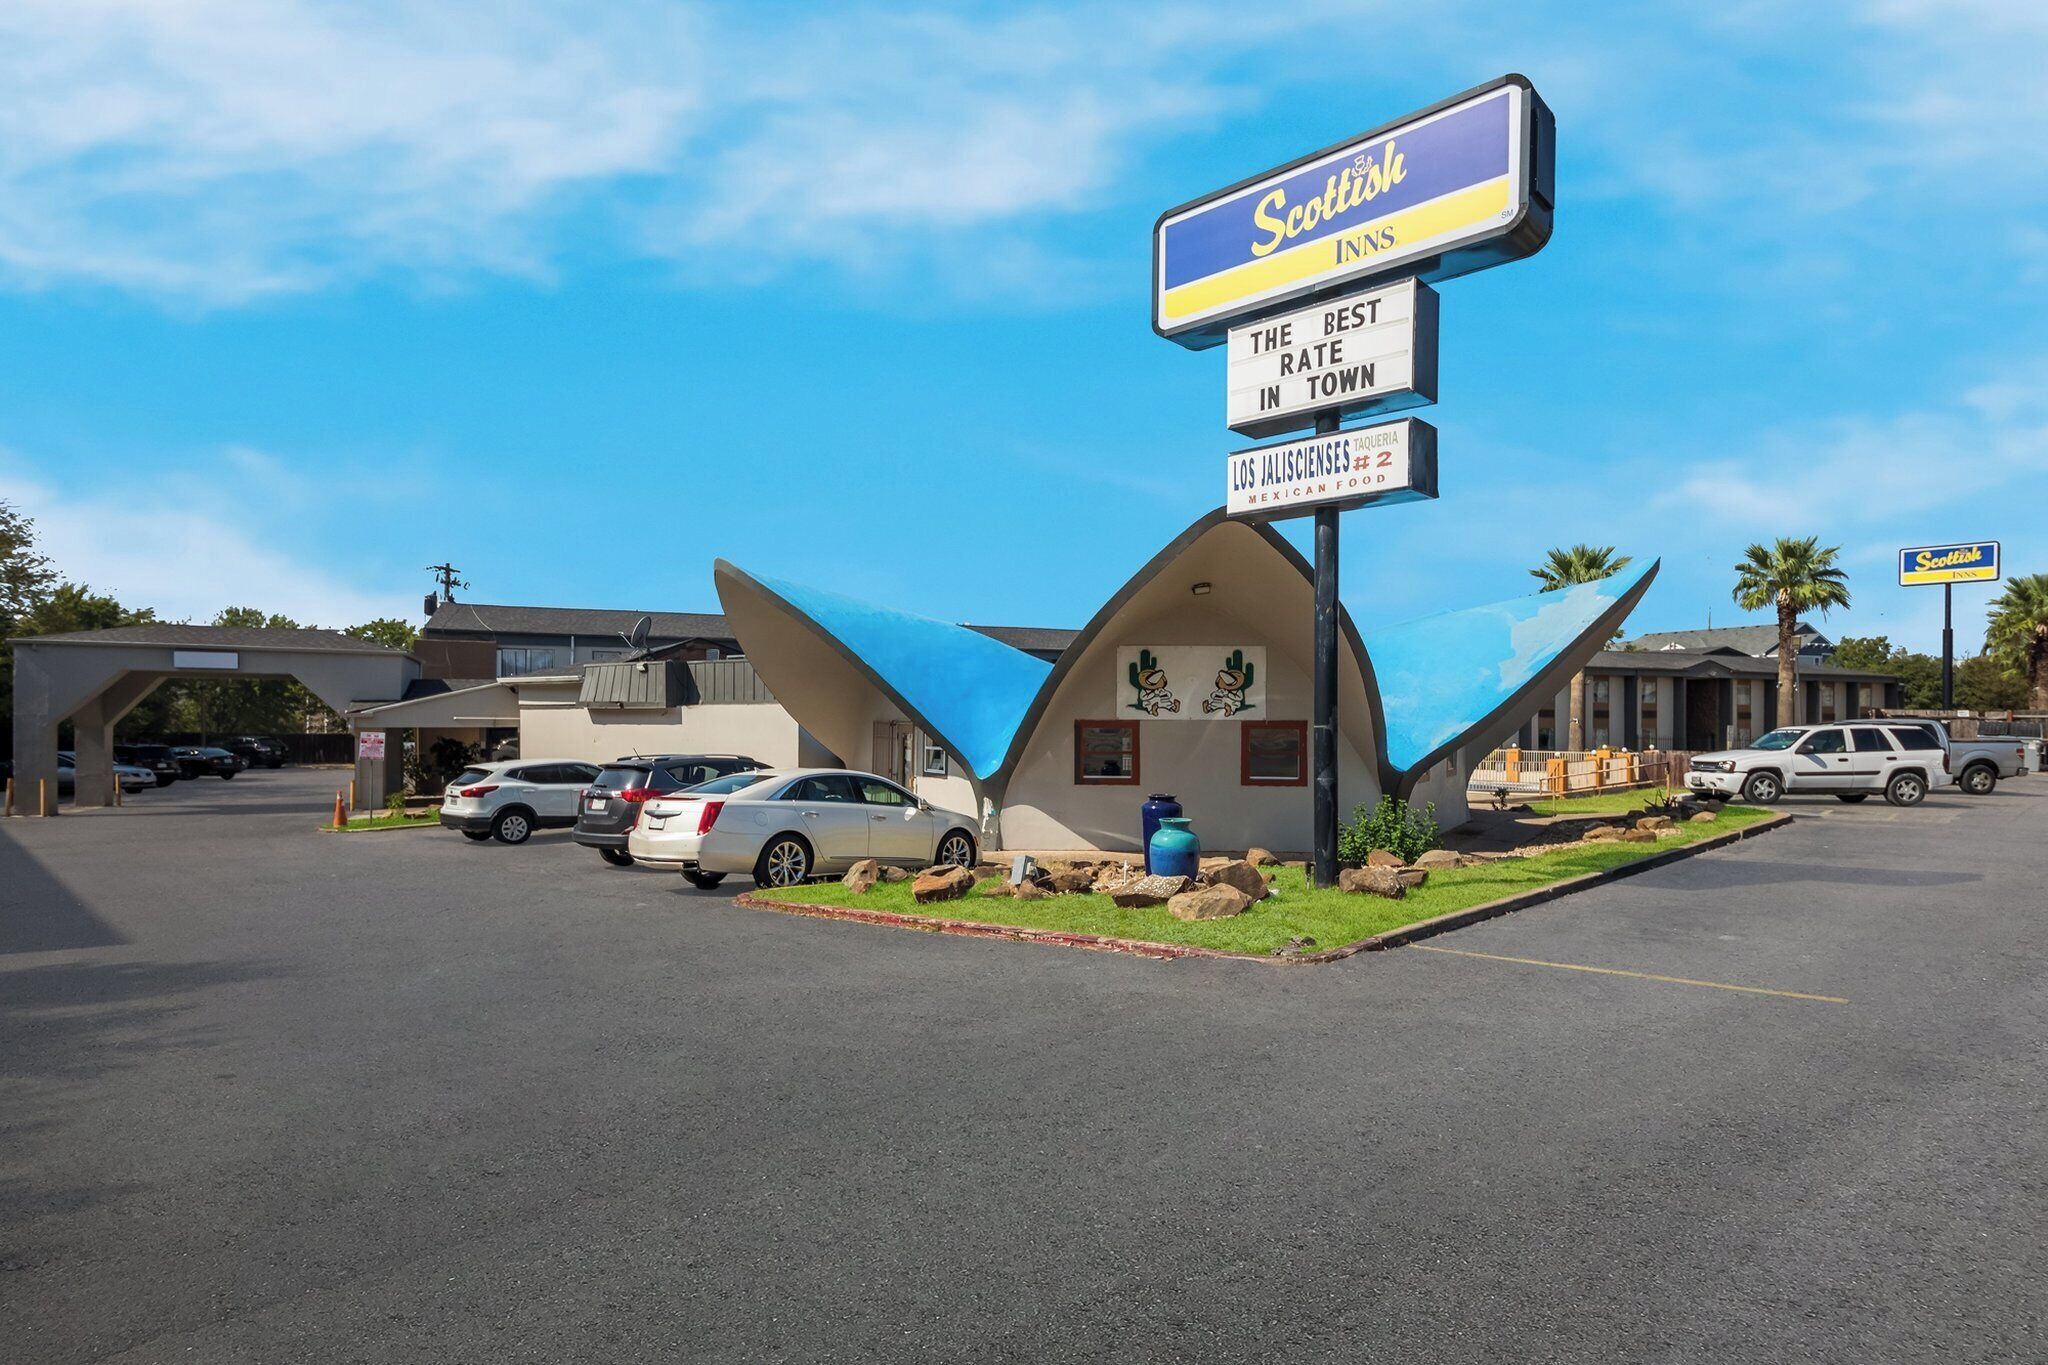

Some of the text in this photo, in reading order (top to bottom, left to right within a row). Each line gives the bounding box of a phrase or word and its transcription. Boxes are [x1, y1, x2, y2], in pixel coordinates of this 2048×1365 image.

[1251, 140, 1407, 257] Scottish
[1335, 226, 1396, 265] INNS
[1250, 298, 1381, 354] THE BEST
[1280, 339, 1343, 377] RATE
[1260, 363, 1375, 411] IN TOWN
[1353, 431, 1399, 452] TAQUERIA
[1233, 439, 1350, 491] LOS JALISCIENSES
[1248, 474, 1386, 504] MEXICAN FOOD
[1915, 546, 1982, 571] Scottish
